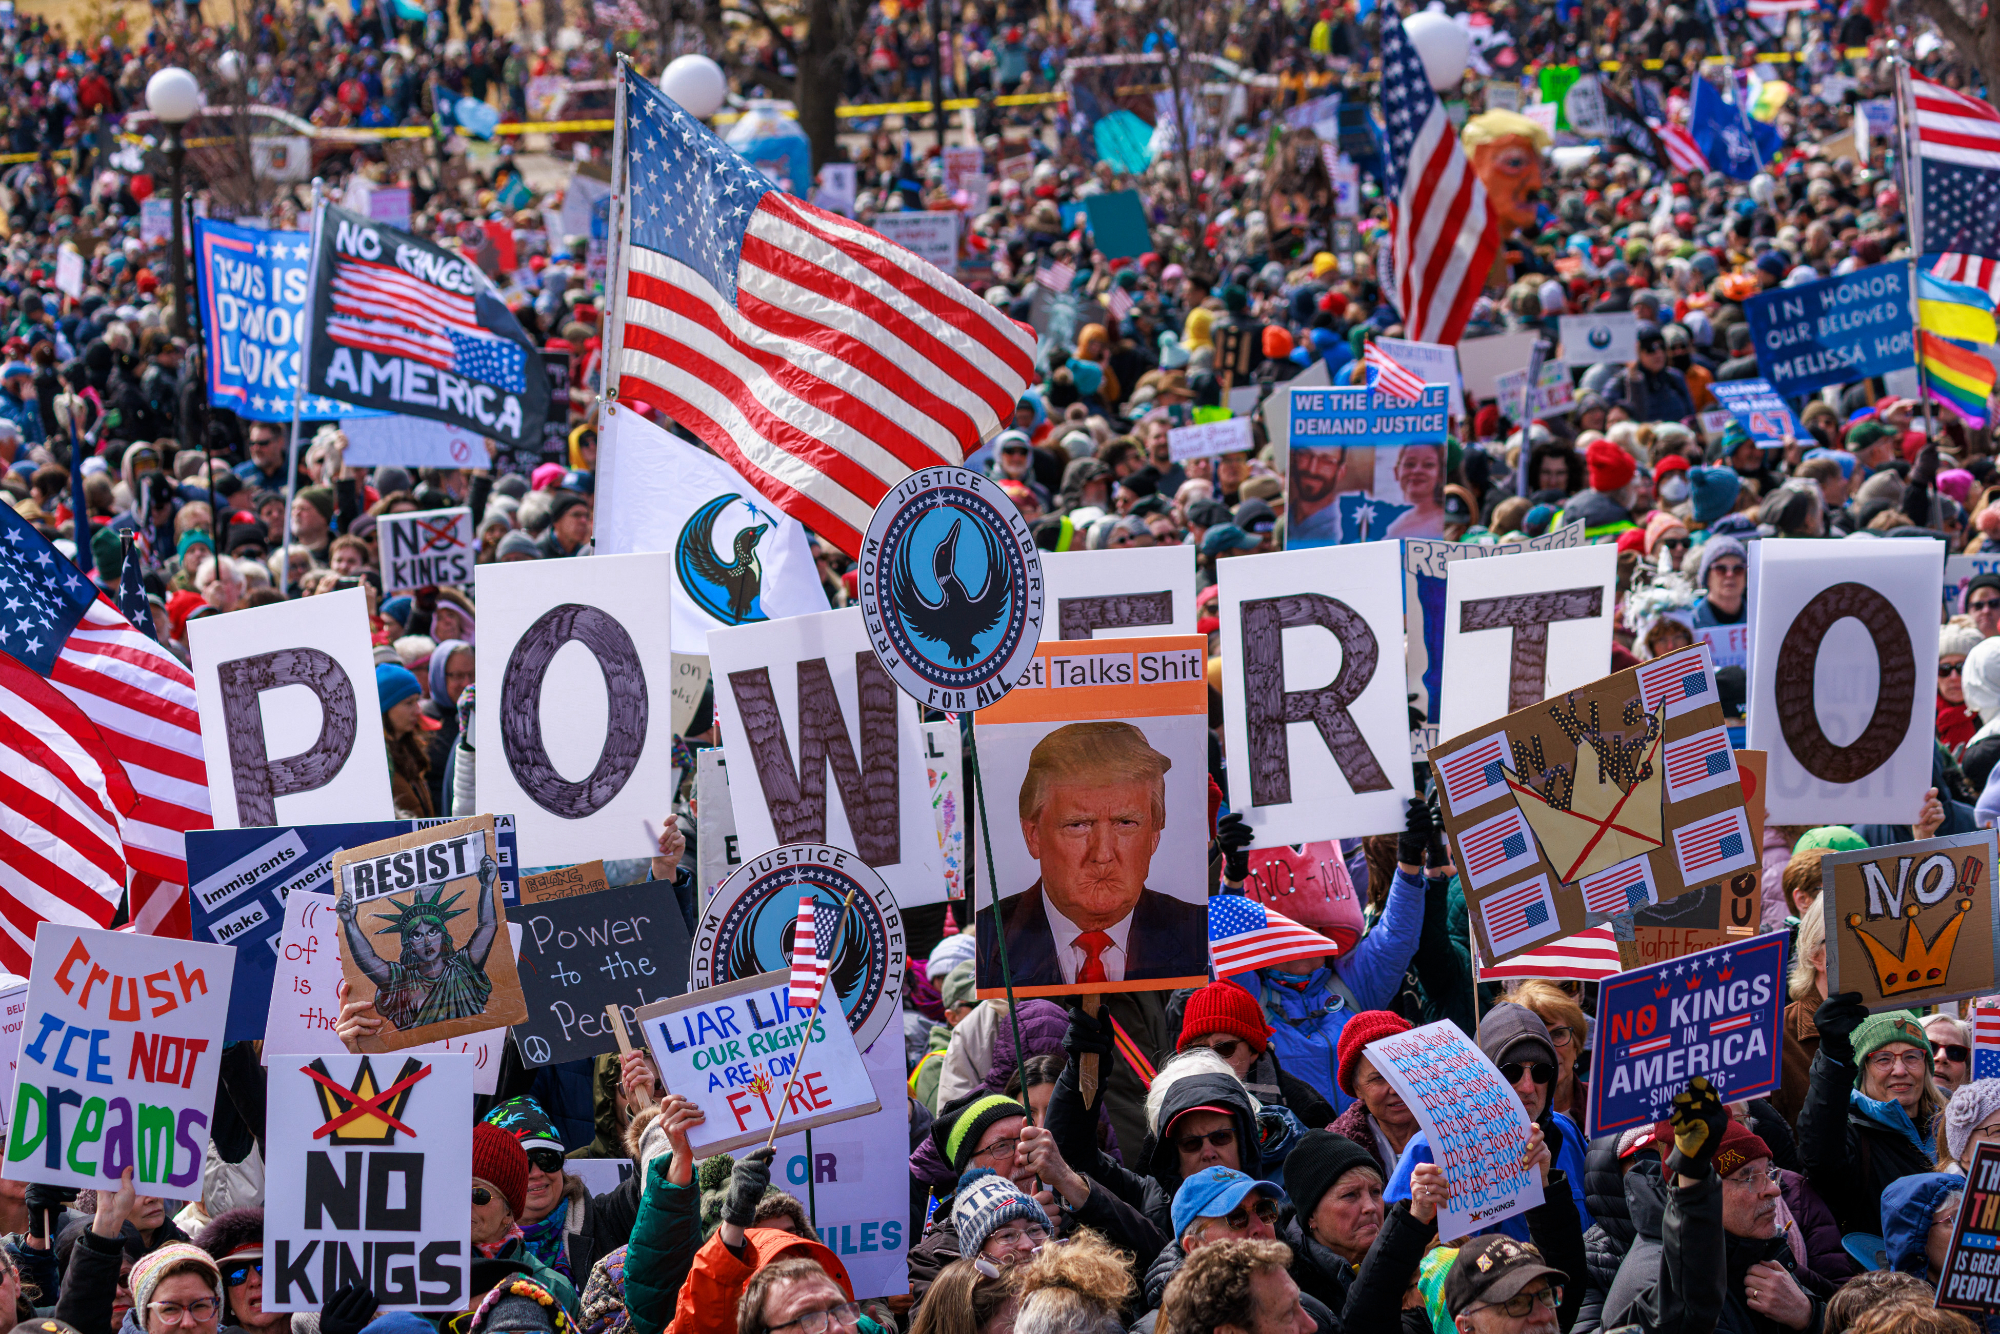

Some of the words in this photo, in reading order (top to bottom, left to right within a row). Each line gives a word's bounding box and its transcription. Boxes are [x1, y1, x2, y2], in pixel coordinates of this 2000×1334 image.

[336, 219, 383, 261] NO
[395, 243, 475, 295] KINGS
[214, 253, 266, 301] THIS
[272, 267, 307, 305] IS
[1767, 296, 1805, 325] IN
[1819, 273, 1902, 311] HONOR
[1766, 322, 1813, 350] OUR
[1817, 301, 1898, 338] BELOVED
[1772, 342, 1866, 382] MELISSA
[1875, 330, 1913, 358] HOR
[325, 347, 523, 439] AMERICA
[1295, 394, 1324, 412] WE
[1329, 392, 1367, 411] THE
[1295, 418, 1367, 436] DEMAND
[1371, 413, 1444, 434] JUSTICE
[1750, 410, 1796, 439] 47
[898, 470, 982, 504] JUSTICE
[391, 516, 459, 558] NO
[393, 552, 467, 588] KINGS
[1008, 514, 1042, 629] LIBERTY
[864, 538, 901, 670] FREEDOM
[1728, 628, 1747, 653] FE
[1017, 661, 1044, 687] st
[1053, 657, 1132, 687] Talks
[1140, 653, 1201, 683] Shit
[672, 686, 698, 710] olis!
[928, 687, 967, 709] FOR
[976, 673, 1013, 708] ALL
[1512, 734, 1573, 811] NO
[202, 844, 297, 906] Immigrants
[279, 859, 334, 900] Americ
[353, 838, 469, 900] RESIST
[525, 868, 583, 893] BELONG
[749, 848, 848, 882] JUSTICE
[1730, 871, 1757, 926] OU
[1858, 852, 1984, 922] NO!!
[216, 909, 264, 941] Make
[528, 915, 651, 954] Power
[1684, 929, 1732, 956] Faci
[284, 936, 319, 964] of
[696, 914, 721, 990] EDOM
[875, 889, 903, 1002] LIBERTY
[54, 935, 208, 1022] Crush
[294, 976, 312, 994] is
[550, 961, 582, 987] to
[600, 951, 657, 980] the
[7, 1002, 27, 1016] BELI
[300, 1007, 338, 1029] the
[659, 1005, 742, 1053] LIAR
[746, 986, 827, 1030] LIA
[1610, 1004, 1658, 1044] NO
[1670, 974, 1771, 1029] KINGS
[24, 1012, 113, 1085] ICE
[128, 1031, 209, 1089] NOT
[692, 1040, 745, 1071] OUR
[748, 1018, 827, 1058] RIGHTS
[1413, 1027, 1458, 1051] People
[1423, 1037, 1469, 1062] People
[1683, 1025, 1697, 1045] IN
[708, 1062, 755, 1093] ARE
[769, 1052, 800, 1077] ON
[1433, 1050, 1479, 1074] People
[1443, 1061, 1489, 1086] People
[1608, 1028, 1767, 1098] AMERICA
[1703, 1070, 1726, 1088] 76
[726, 1071, 832, 1132] FIRE
[1452, 1070, 1498, 1102] People
[1463, 1085, 1507, 1114] People
[1470, 1094, 1514, 1129] People
[1476, 1111, 1521, 1143] People
[7, 1082, 208, 1188] Dreams
[1482, 1121, 1526, 1159] People
[786, 1152, 838, 1185] OR
[1485, 1141, 1527, 1175] People
[1718, 1149, 1745, 1174] M
[1977, 1159, 2000, 1192] TH
[303, 1150, 425, 1232] NO
[1489, 1170, 1532, 1205] People
[1483, 1207, 1494, 1218] NO
[1494, 1200, 1515, 1213] KINGS
[275, 1240, 464, 1306] KINGS
[1954, 1250, 1968, 1271] IS
[1969, 1252, 2000, 1276] GREA
